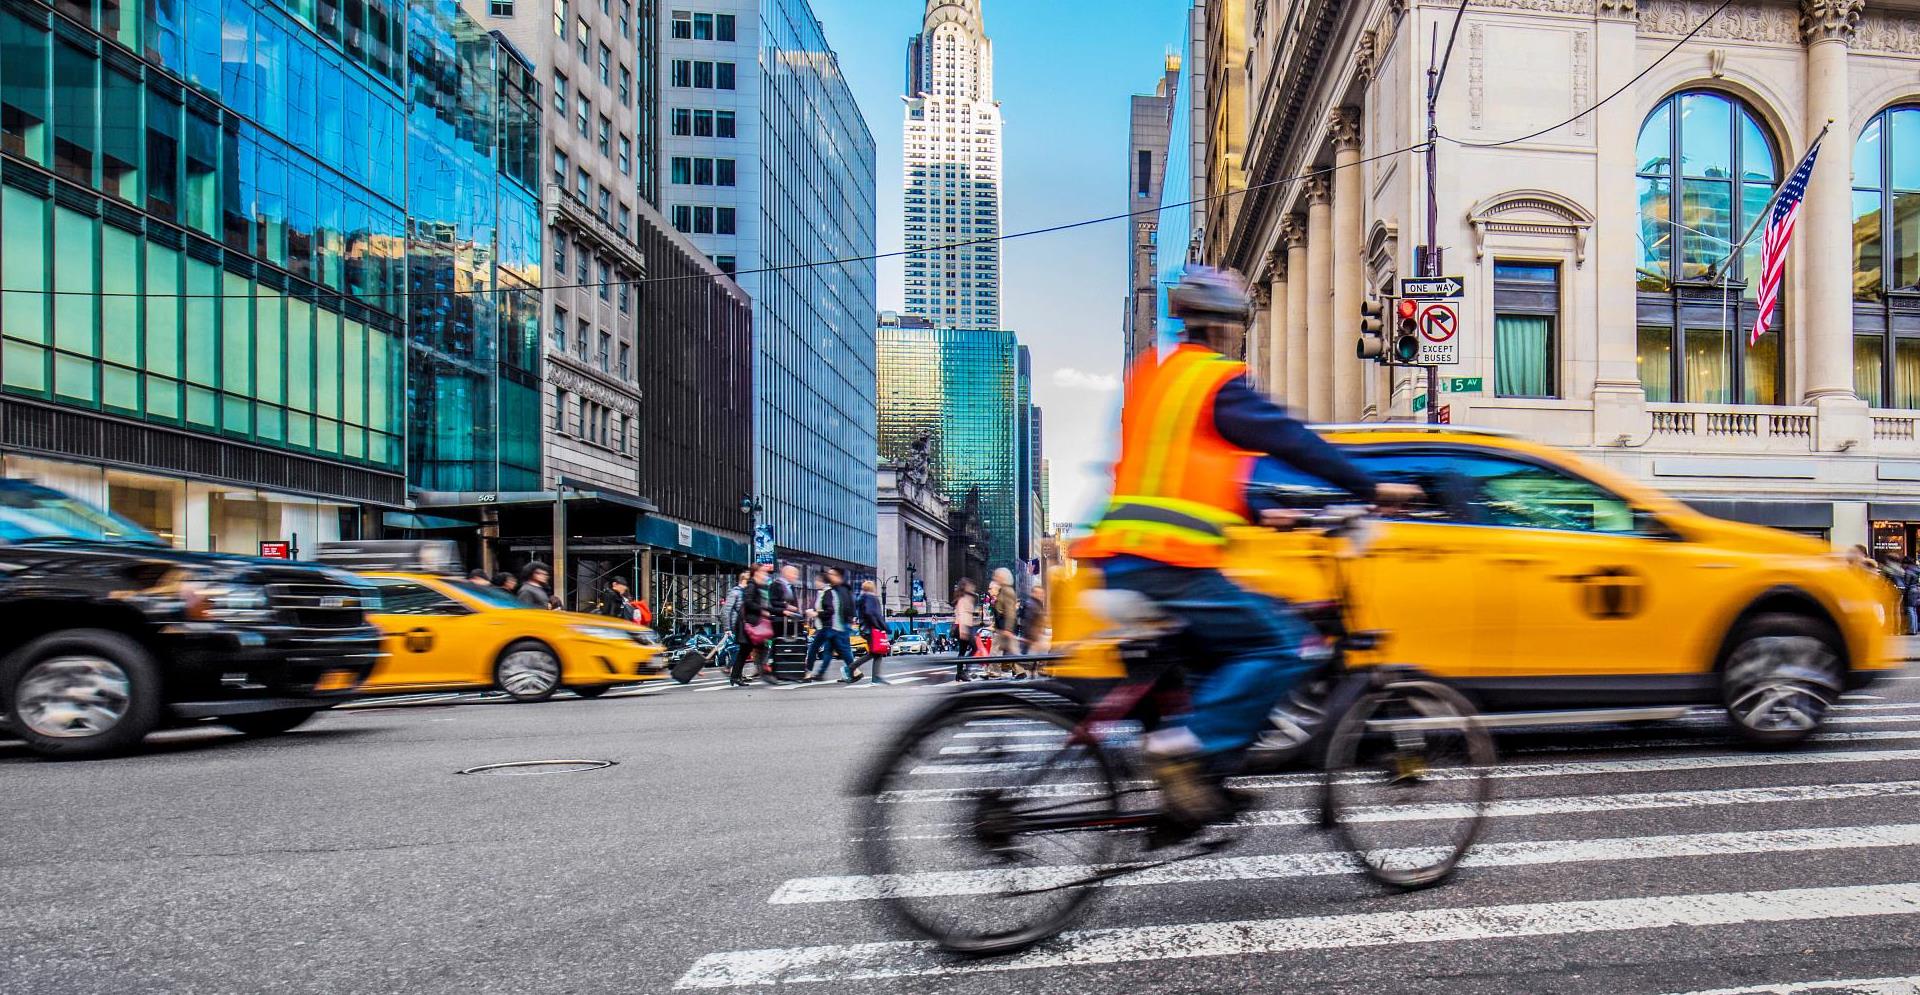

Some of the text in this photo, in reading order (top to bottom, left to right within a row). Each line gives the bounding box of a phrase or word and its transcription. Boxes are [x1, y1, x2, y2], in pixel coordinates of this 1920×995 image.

[1410, 283, 1455, 292] ONE WAY
[1455, 379, 1464, 391] 5
